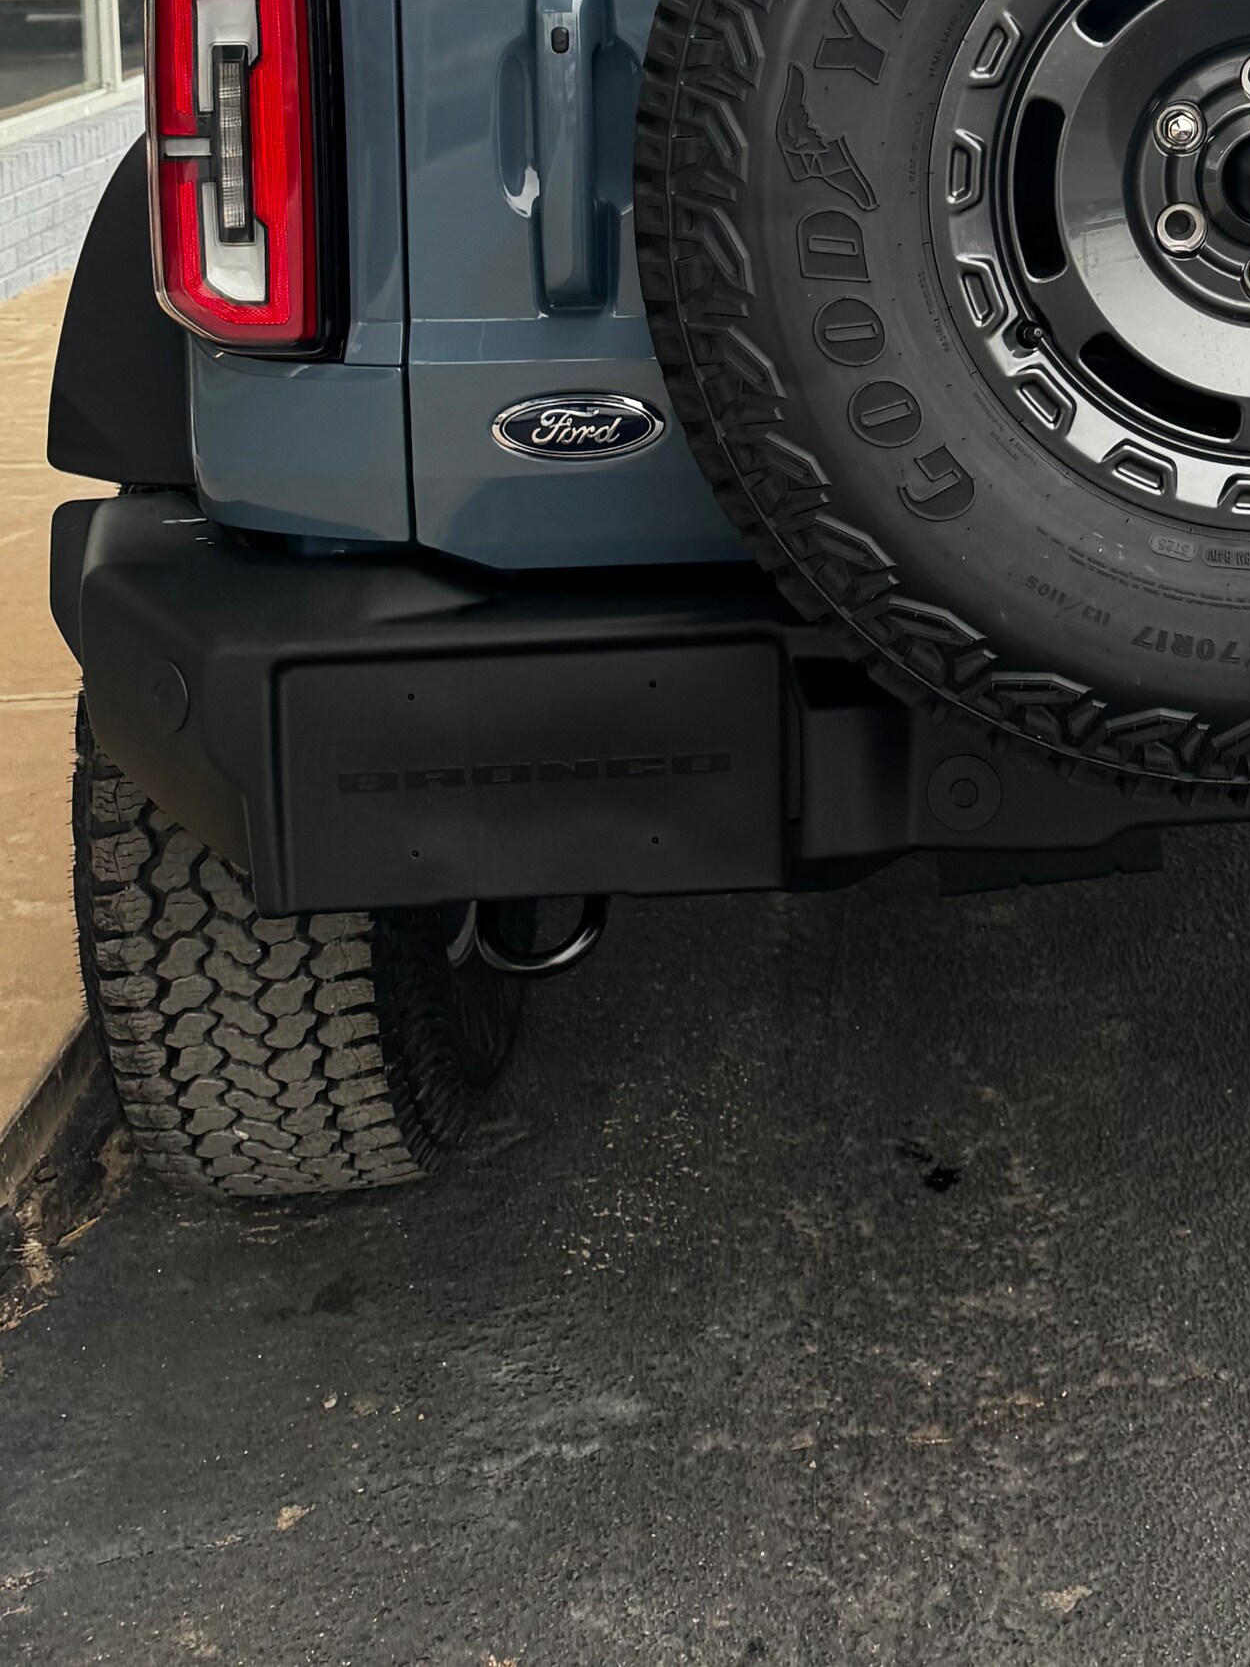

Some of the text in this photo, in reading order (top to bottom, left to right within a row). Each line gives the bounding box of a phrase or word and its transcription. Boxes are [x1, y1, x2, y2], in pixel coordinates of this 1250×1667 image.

[531, 408, 623, 446] Ford
[1025, 574, 1112, 628] 113/110S
[337, 752, 731, 794] BRONCO
